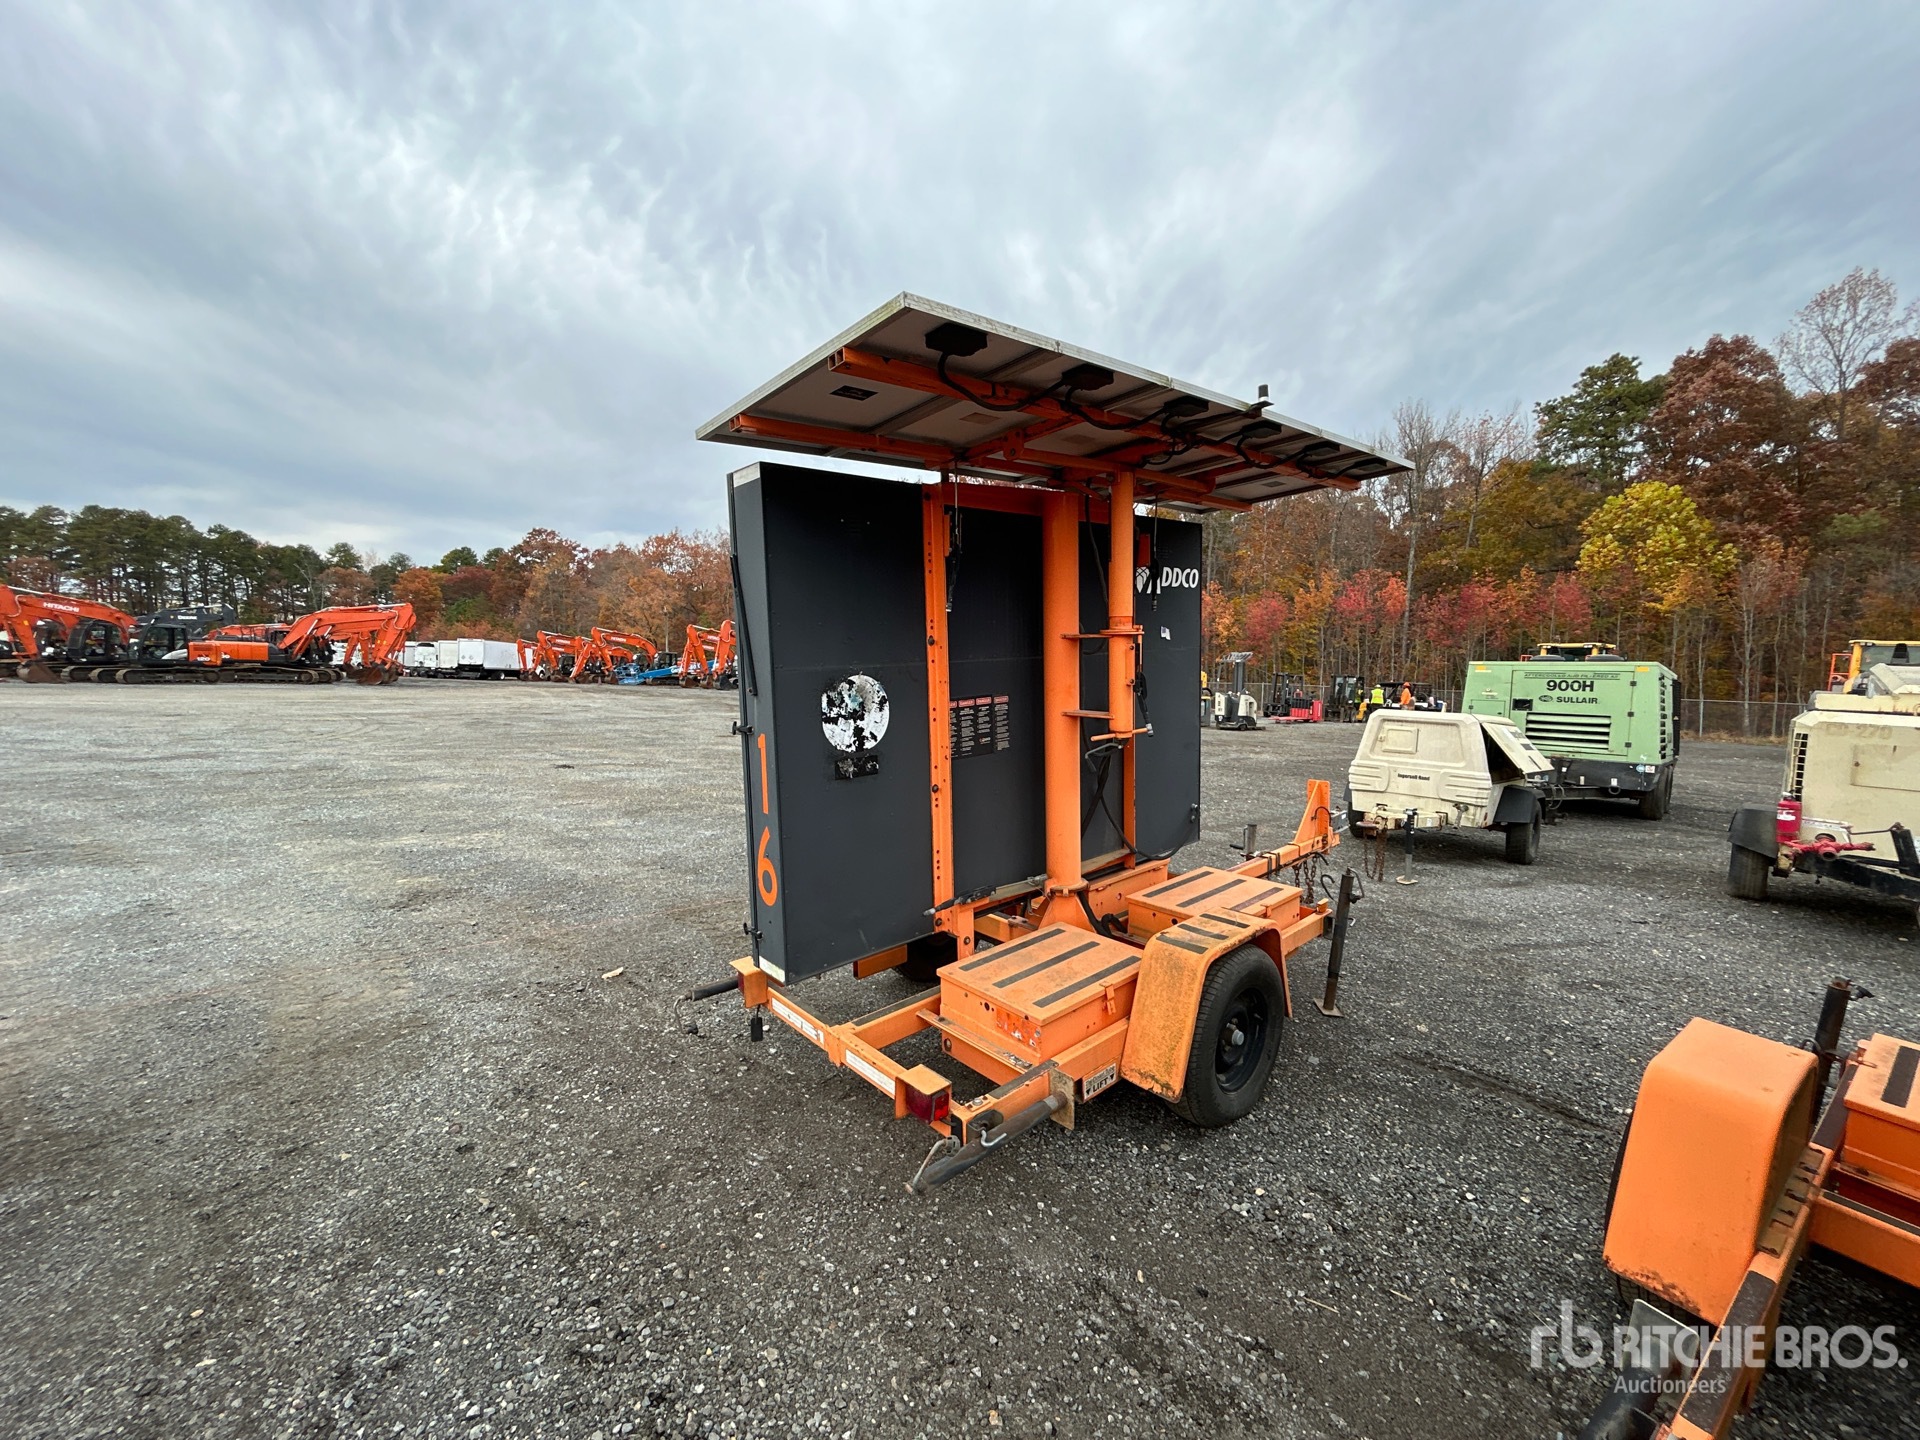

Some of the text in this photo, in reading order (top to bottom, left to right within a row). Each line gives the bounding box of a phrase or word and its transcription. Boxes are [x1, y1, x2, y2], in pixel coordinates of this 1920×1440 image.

[43, 602, 80, 613] HITACHI
[1546, 679, 1595, 692] 900H
[1556, 696, 1599, 704] SULLAIR
[1092, 1076, 1109, 1092] LIFT
